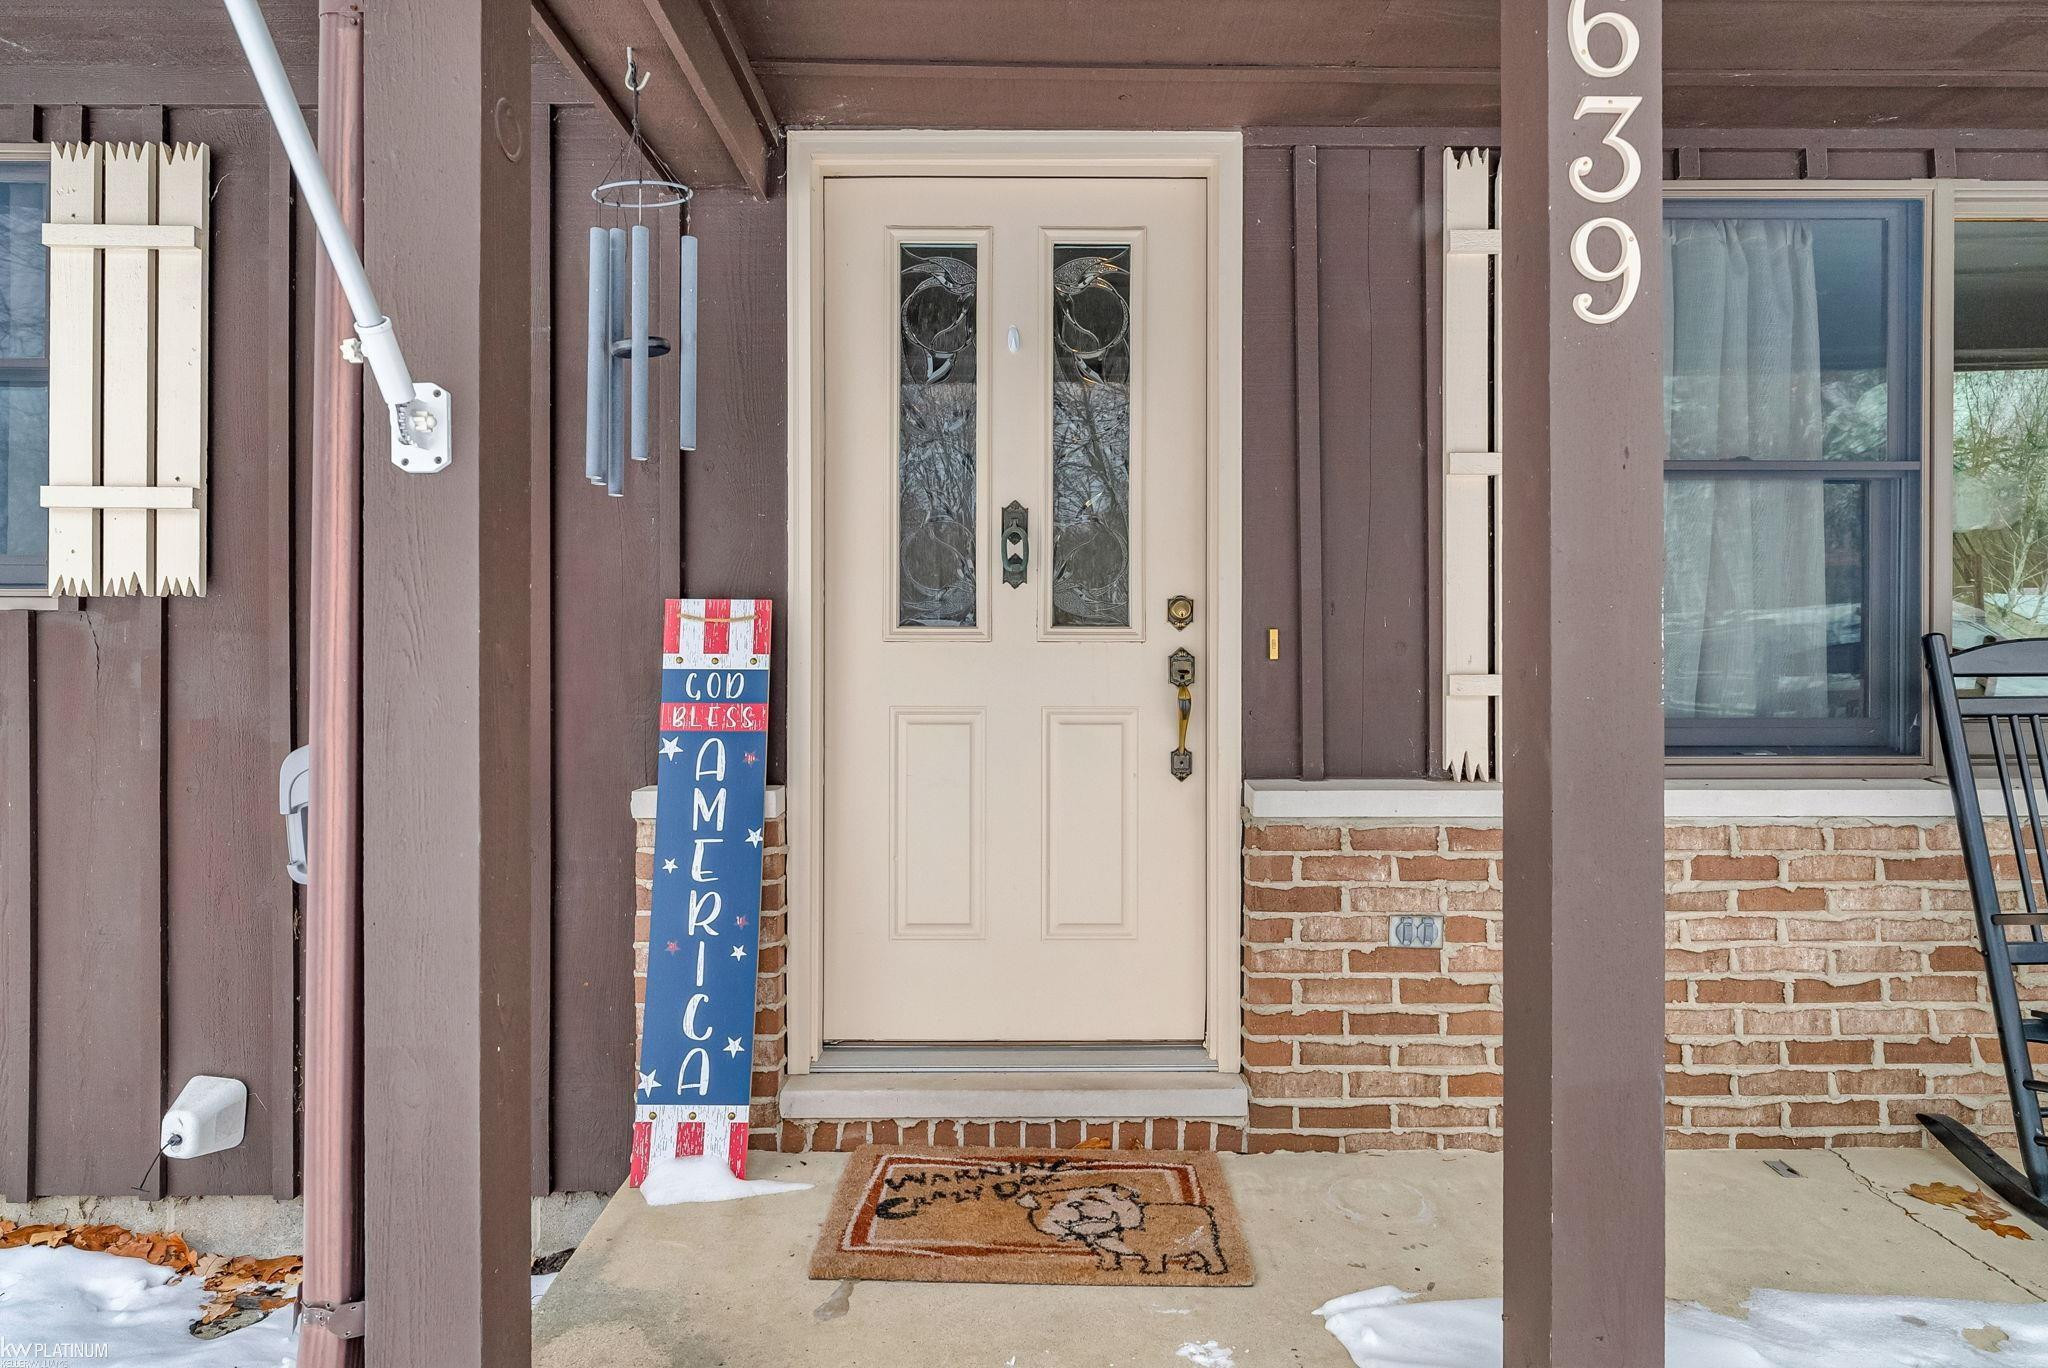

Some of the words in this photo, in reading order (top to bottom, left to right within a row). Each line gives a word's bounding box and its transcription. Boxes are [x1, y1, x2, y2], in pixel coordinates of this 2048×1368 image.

[1567, 0, 1643, 325] 639
[672, 705, 755, 728] BLESS
[685, 672, 745, 701] GOD
[676, 737, 727, 1097] AMERICA
